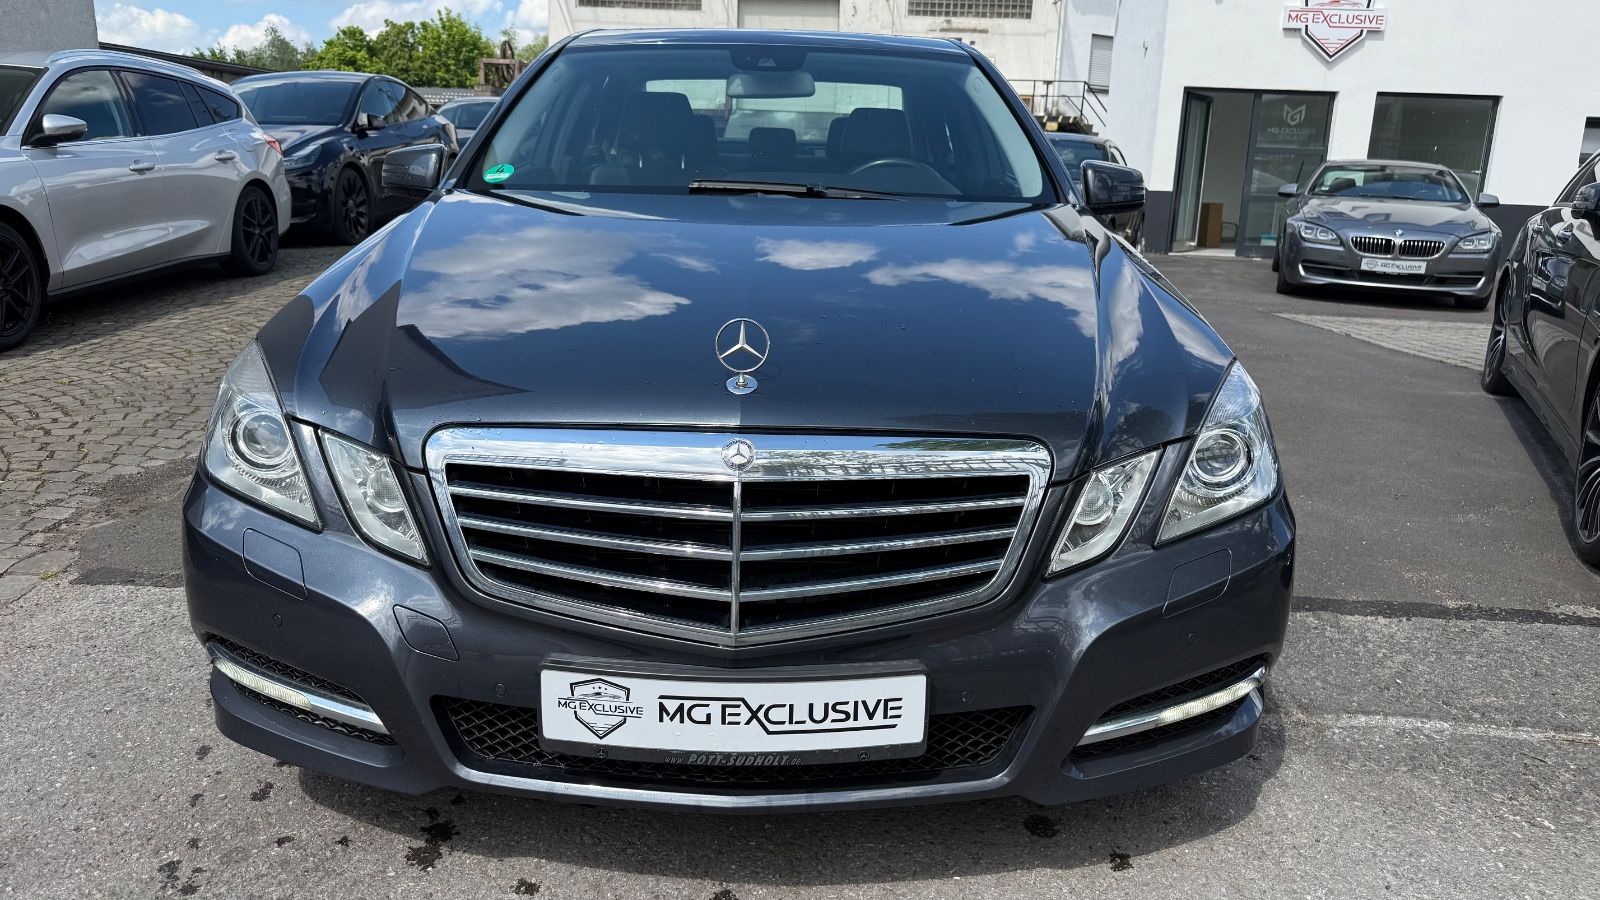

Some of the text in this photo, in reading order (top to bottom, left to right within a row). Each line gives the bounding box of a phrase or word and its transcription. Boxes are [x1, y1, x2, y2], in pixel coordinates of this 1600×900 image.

[1287, 13, 1385, 25] MG EXCLUSIVE
[496, 164, 505, 173] 4
[558, 700, 644, 715] MG EXCLUSIVE
[658, 698, 903, 725] MG EXCLUSIVE
